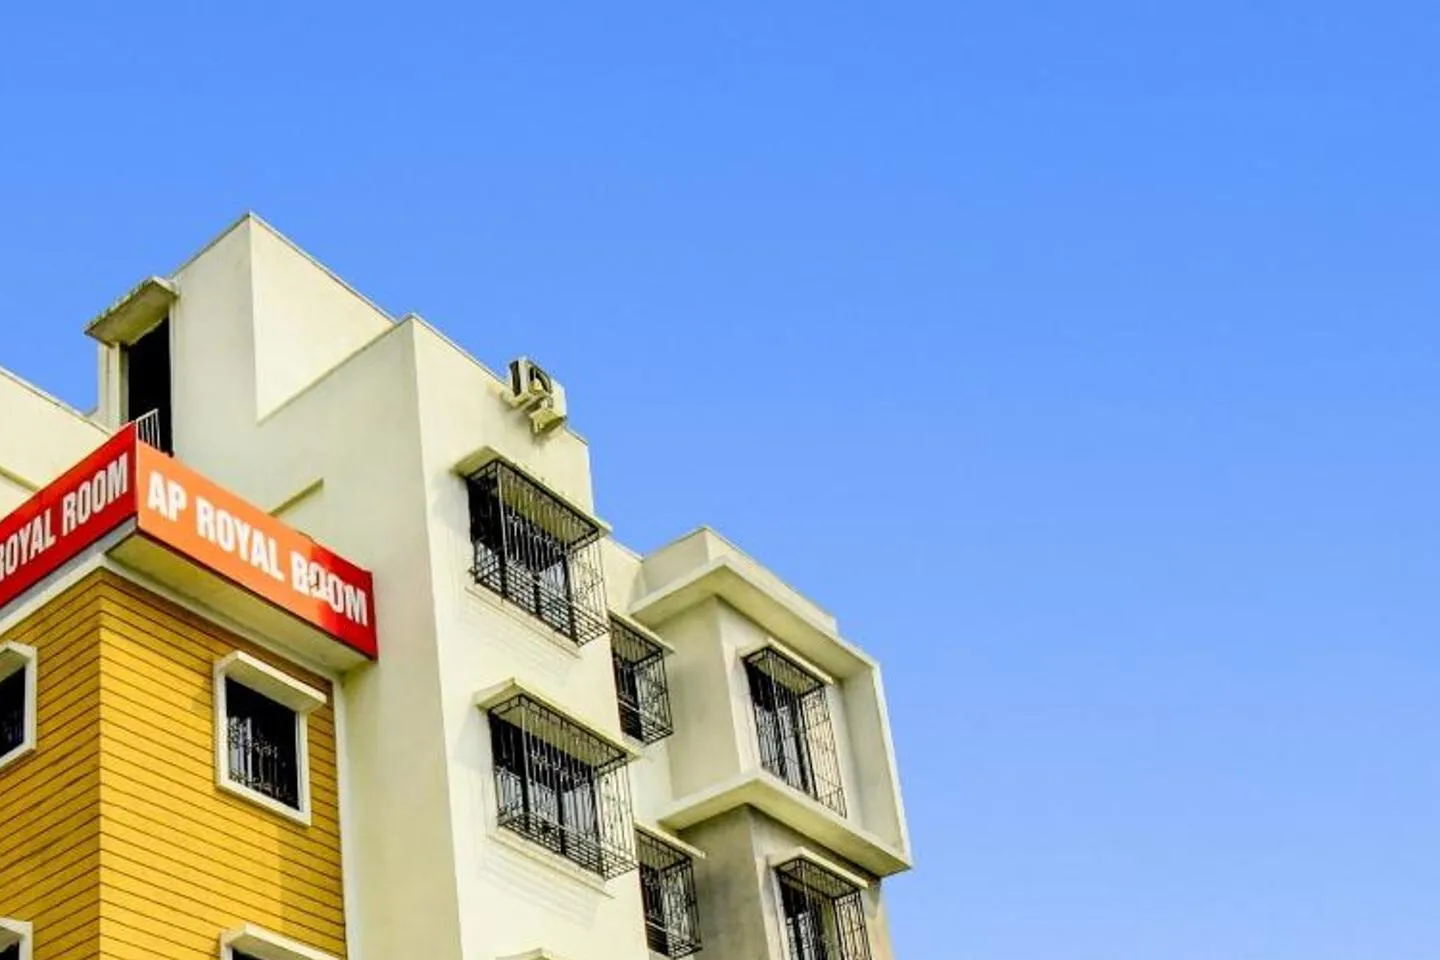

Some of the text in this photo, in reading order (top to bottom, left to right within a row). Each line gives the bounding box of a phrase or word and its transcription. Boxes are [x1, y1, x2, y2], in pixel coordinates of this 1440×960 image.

[62, 452, 129, 537] ROOM
[147, 470, 188, 522] AP
[195, 495, 286, 582] ROYAL
